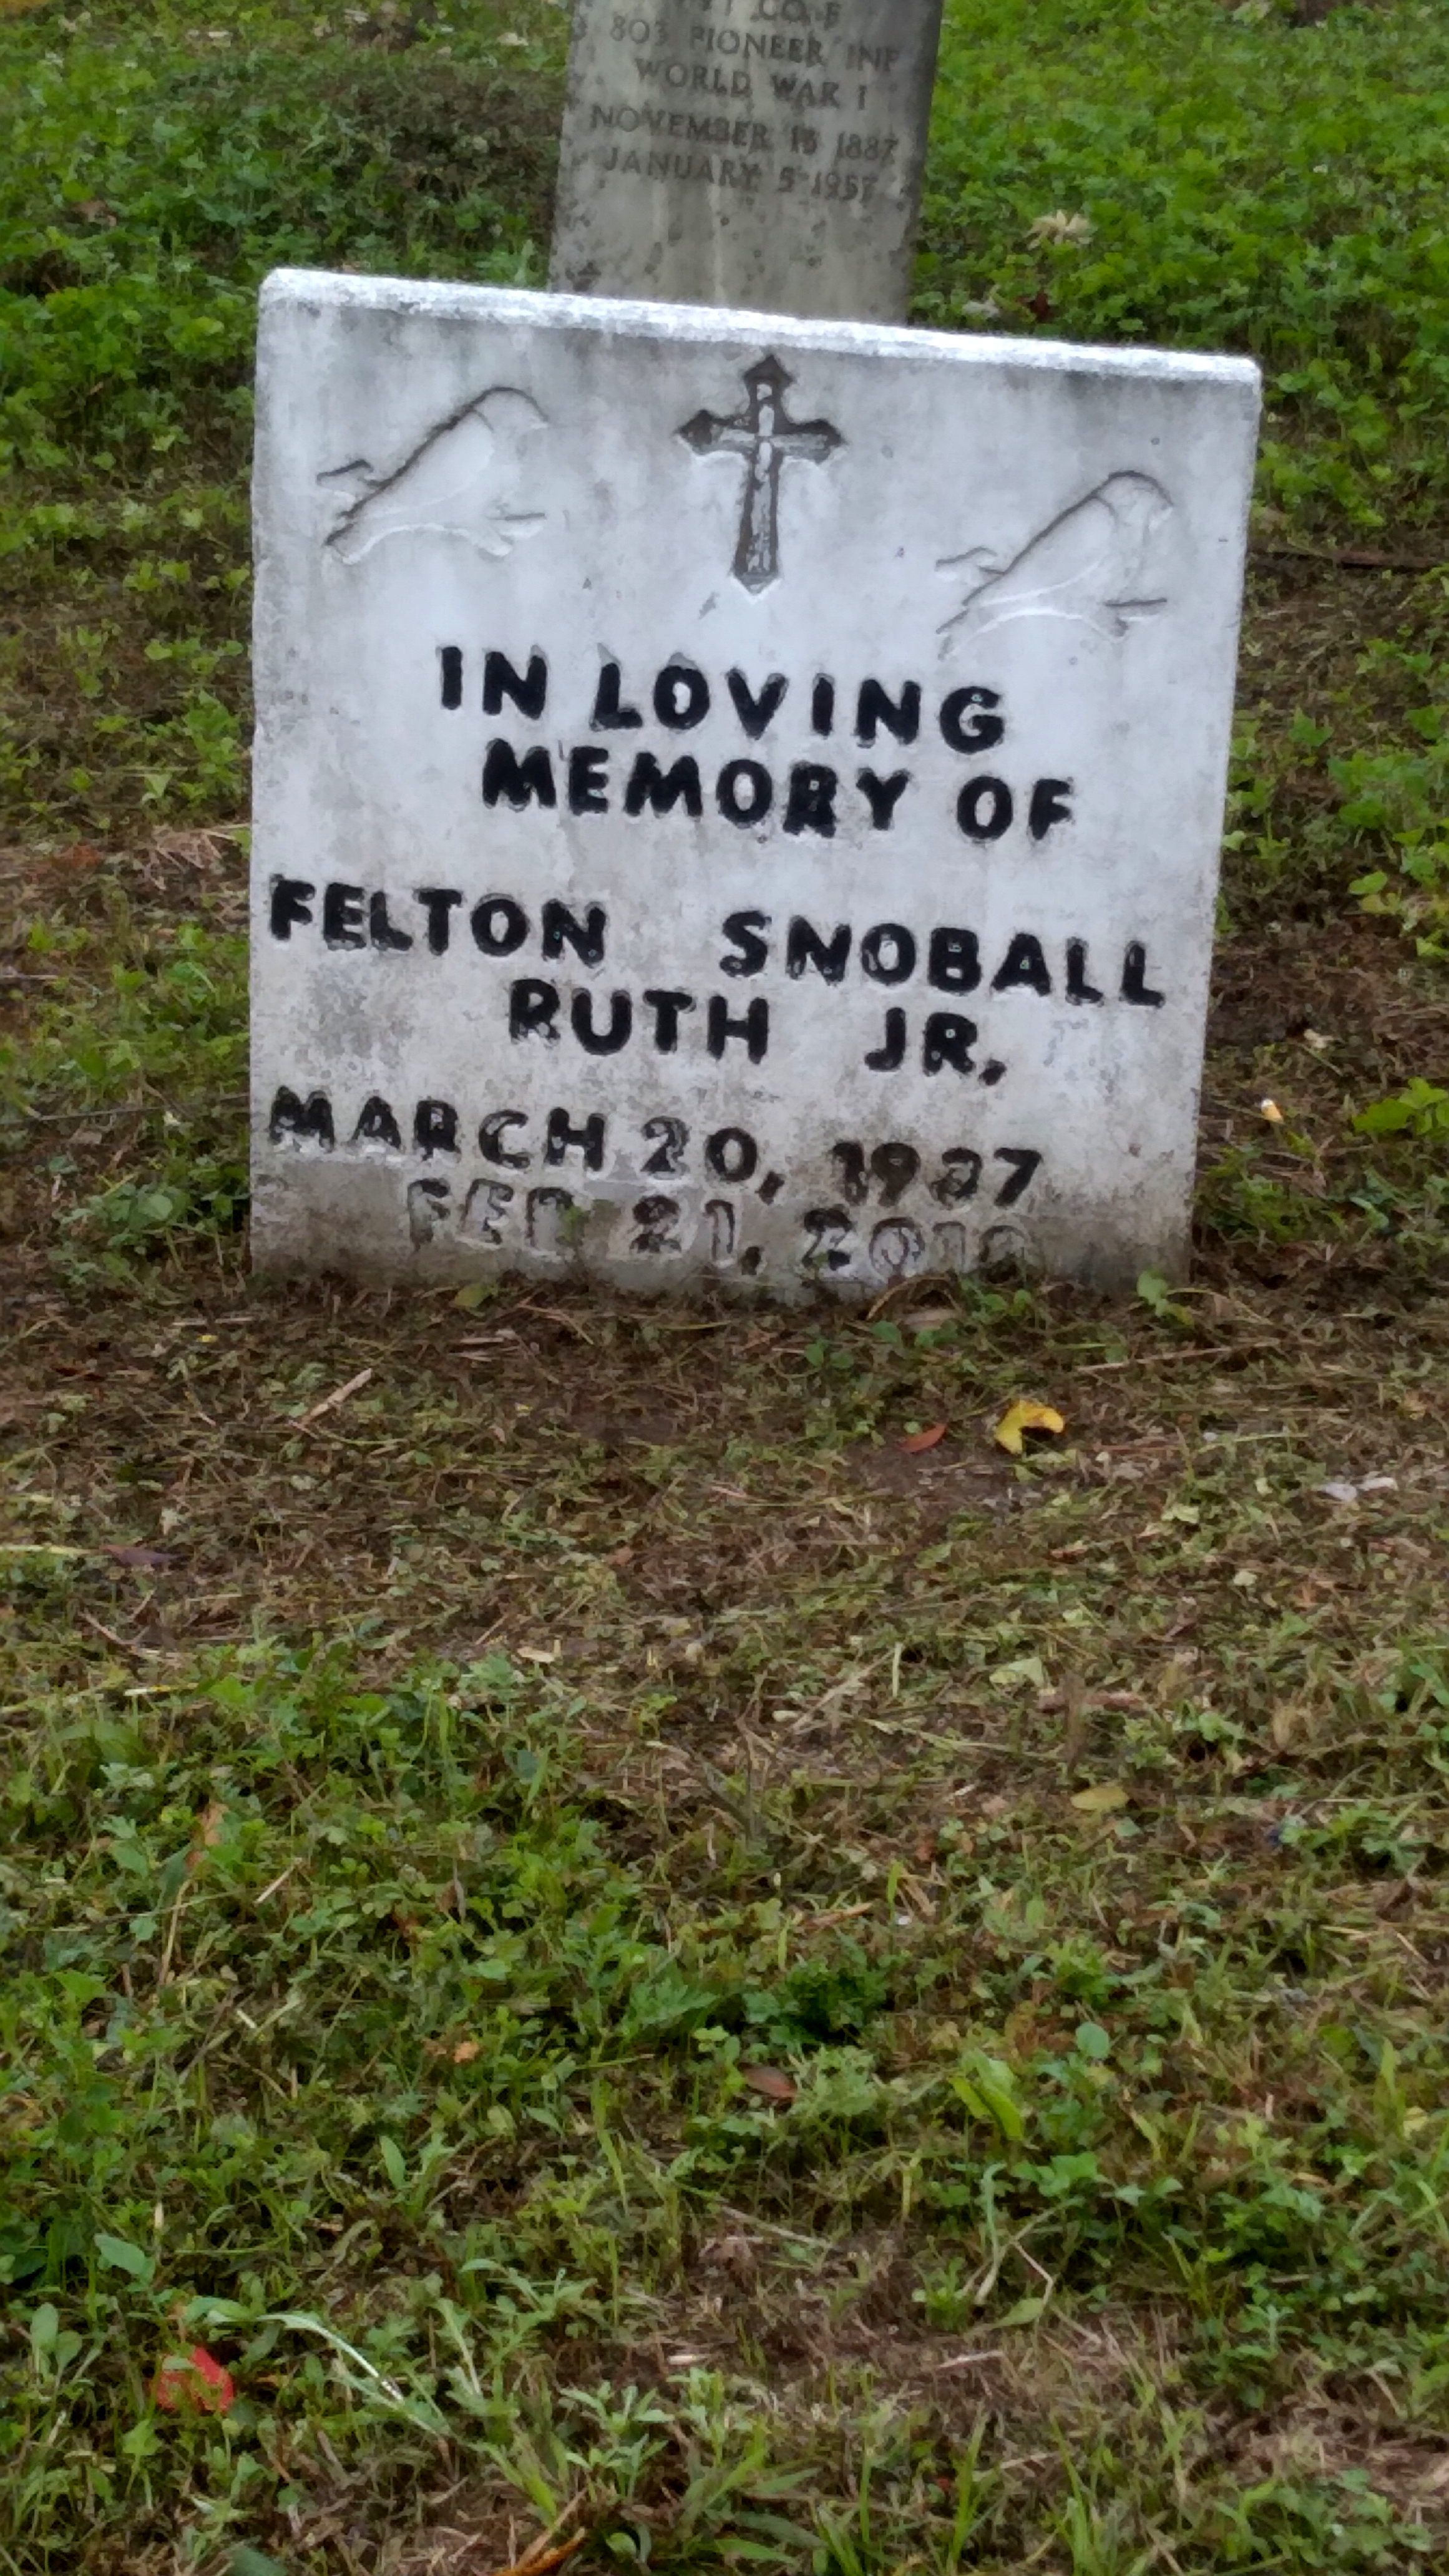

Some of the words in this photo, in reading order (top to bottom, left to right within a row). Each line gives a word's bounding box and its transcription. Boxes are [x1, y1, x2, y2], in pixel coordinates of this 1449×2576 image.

[635, 60, 750, 98] WORLD
[771, 76, 839, 109] WAR
[690, 26, 822, 65] PIONEER
[592, 105, 770, 150] NOVEMBER
[603, 147, 760, 189] JANUARY
[436, 645, 548, 719] IN
[590, 652, 1006, 753] LOVING
[482, 739, 910, 837] MEMORY
[956, 775, 1073, 841] OF
[270, 877, 607, 967] FELTON
[720, 910, 1166, 1007] SNOBALL
[509, 978, 769, 1065] RUTH
[269, 1086, 607, 1171] MARCH
